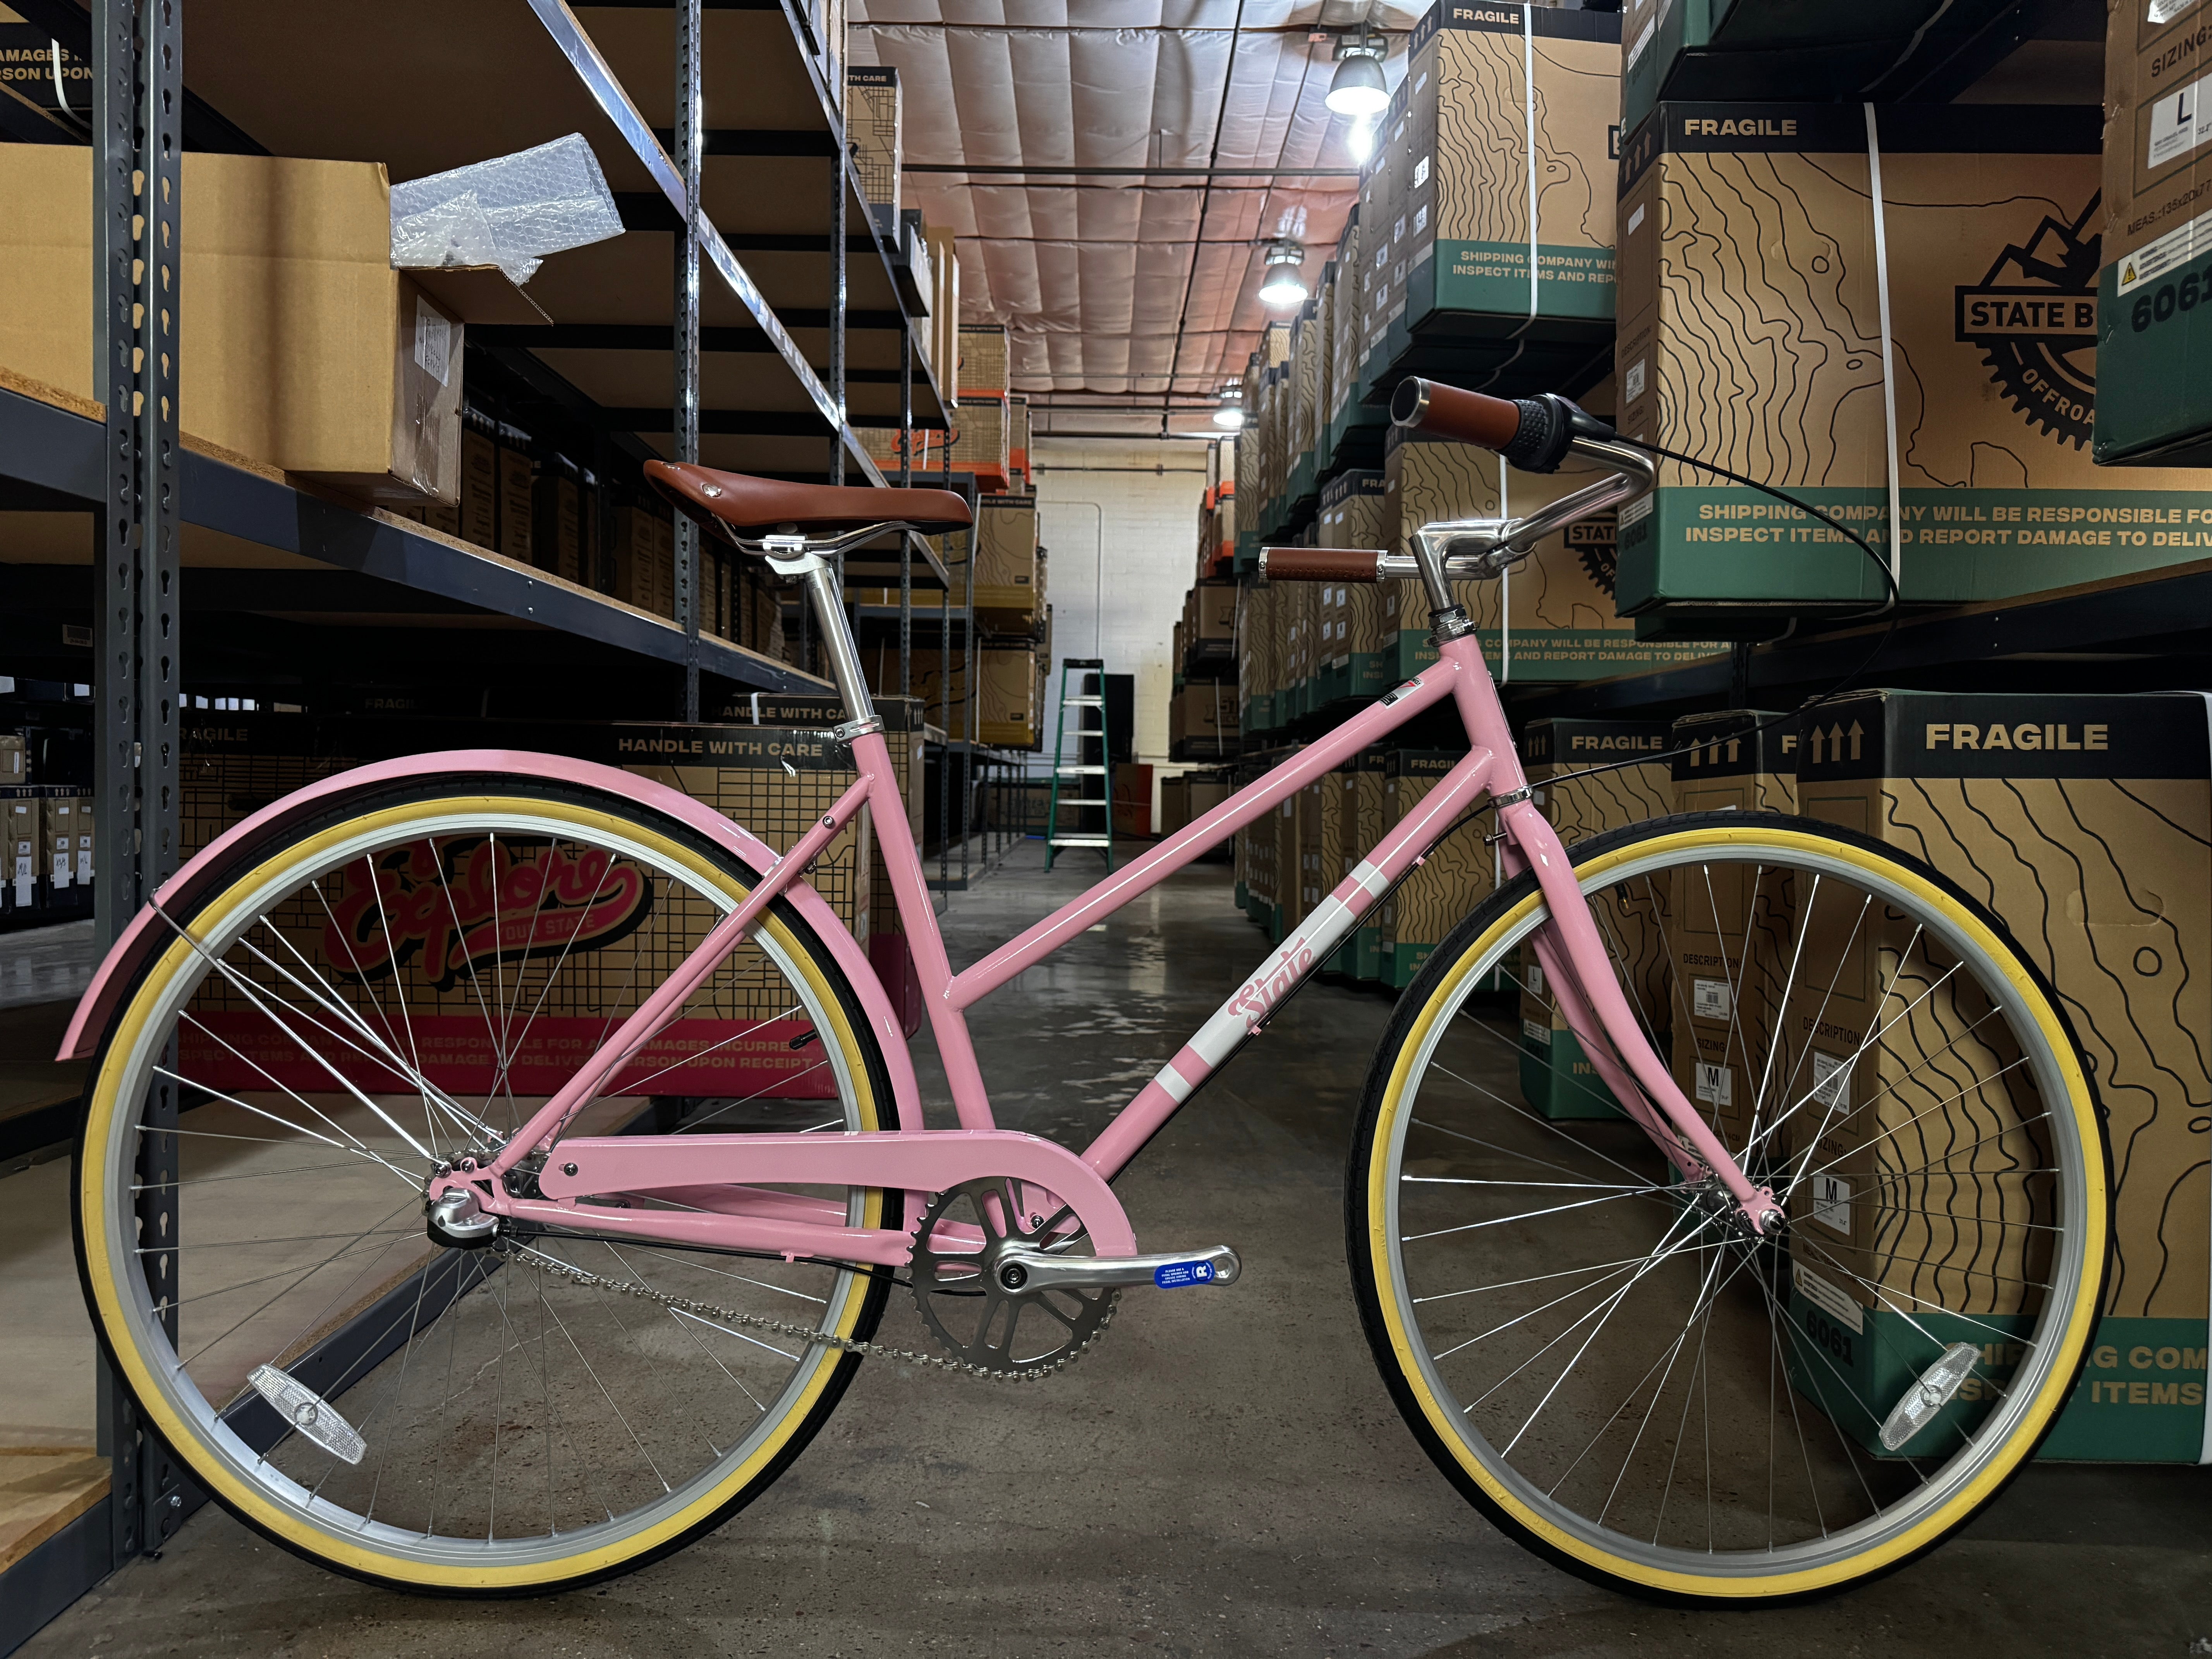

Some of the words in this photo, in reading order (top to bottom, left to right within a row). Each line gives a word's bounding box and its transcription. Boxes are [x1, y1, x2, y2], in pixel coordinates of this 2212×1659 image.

[1453, 8, 1519, 24] FRAGILE
[2177, 92, 2192, 125] L
[1685, 119, 1797, 136] FRAGILE
[1461, 251, 1524, 264] SHIPPING
[1453, 264, 1511, 277] INSPECT
[1557, 271, 1585, 282] AND
[1970, 301, 2065, 328] STATE
[2075, 302, 2094, 328] B
[1699, 505, 1807, 520] SHIPPING
[1933, 506, 1987, 522] WILL
[1992, 507, 2022, 522] BE
[2027, 507, 2182, 524] RESPONSIBLE
[1573, 526, 1616, 540] STAT
[1686, 527, 1784, 543] INSPECT
[1919, 529, 2012, 544] REPORT
[2017, 529, 2111, 546] DAMAGE
[2117, 531, 2147, 546] TO
[1551, 639, 1582, 648] WILL
[1583, 639, 1601, 648] BE
[1514, 652, 1542, 661] AND
[1544, 652, 1595, 661] REPORT
[1599, 652, 1652, 661] DAMAGE
[1654, 652, 1671, 661] TO
[778, 707, 821, 720] WITH
[1571, 735, 1663, 750] FRAGILE
[1926, 723, 2108, 750] FRAGILE
[618, 738, 703, 754] HANDLE
[708, 740, 762, 756] WITH
[767, 742, 822, 757] CARE
[493, 921, 537, 941] YOUR
[543, 914, 594, 935] STATE
[1227, 937, 1316, 1029] State
[686, 1057, 735, 1070] UPON
[1707, 1067, 1719, 1087] M
[1824, 1177, 1837, 1204] M
[1805, 1310, 1853, 1368] 6061
[2090, 1381, 2202, 1406] ITEMS
